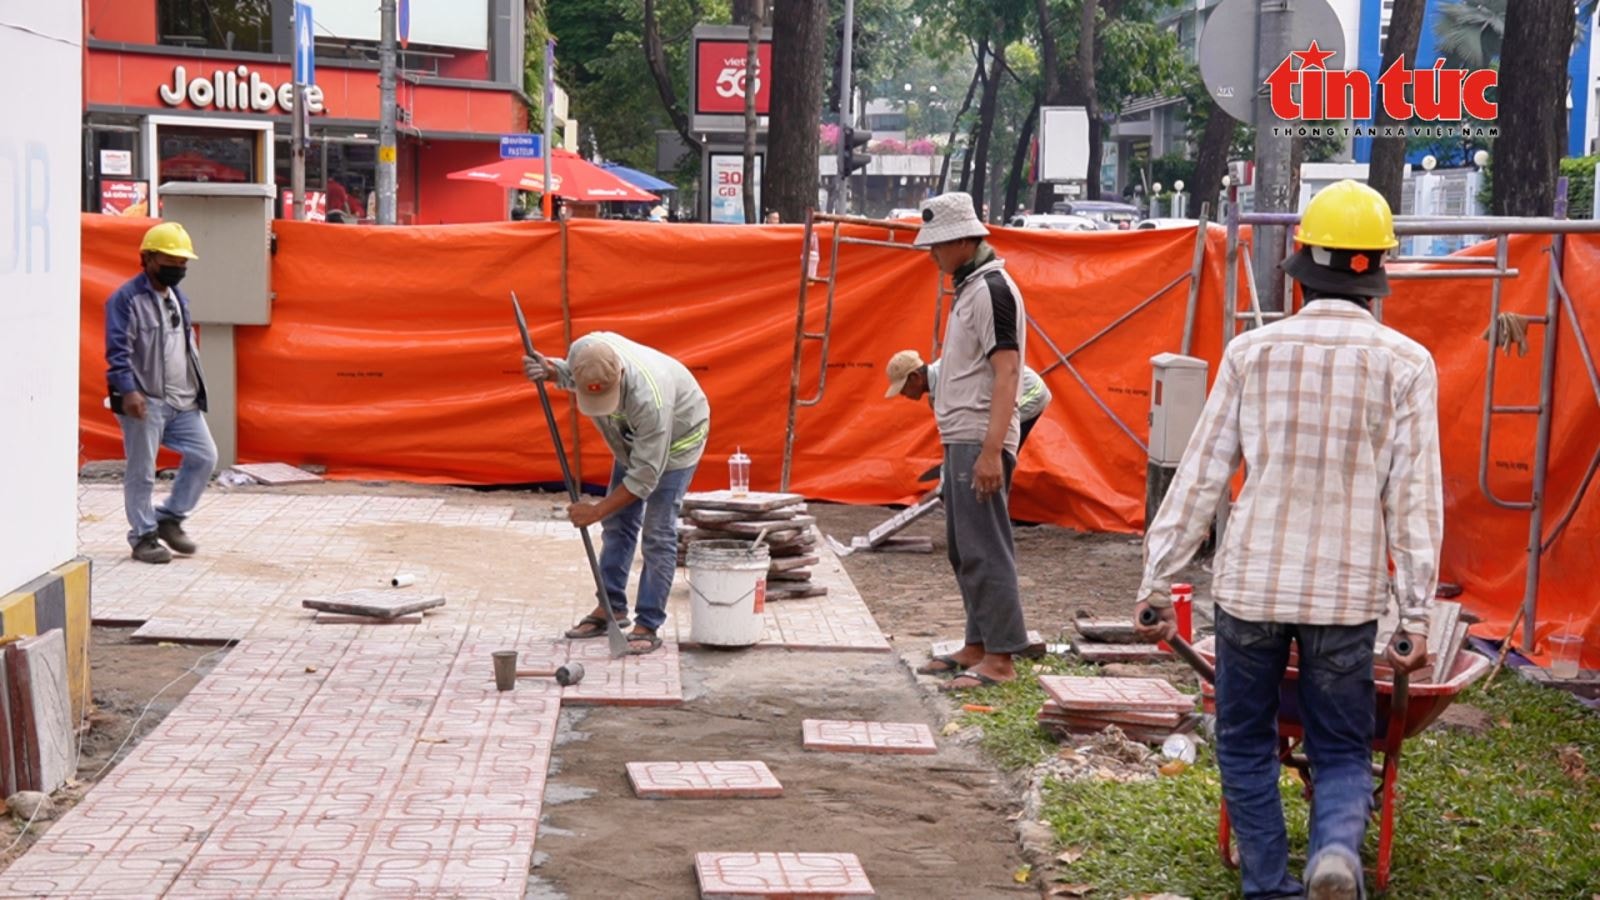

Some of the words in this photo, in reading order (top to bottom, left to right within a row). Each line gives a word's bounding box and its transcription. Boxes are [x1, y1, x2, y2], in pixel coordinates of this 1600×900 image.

[160, 65, 324, 113] Jollibee
[718, 171, 742, 185] 30
[719, 187, 736, 197] GB
